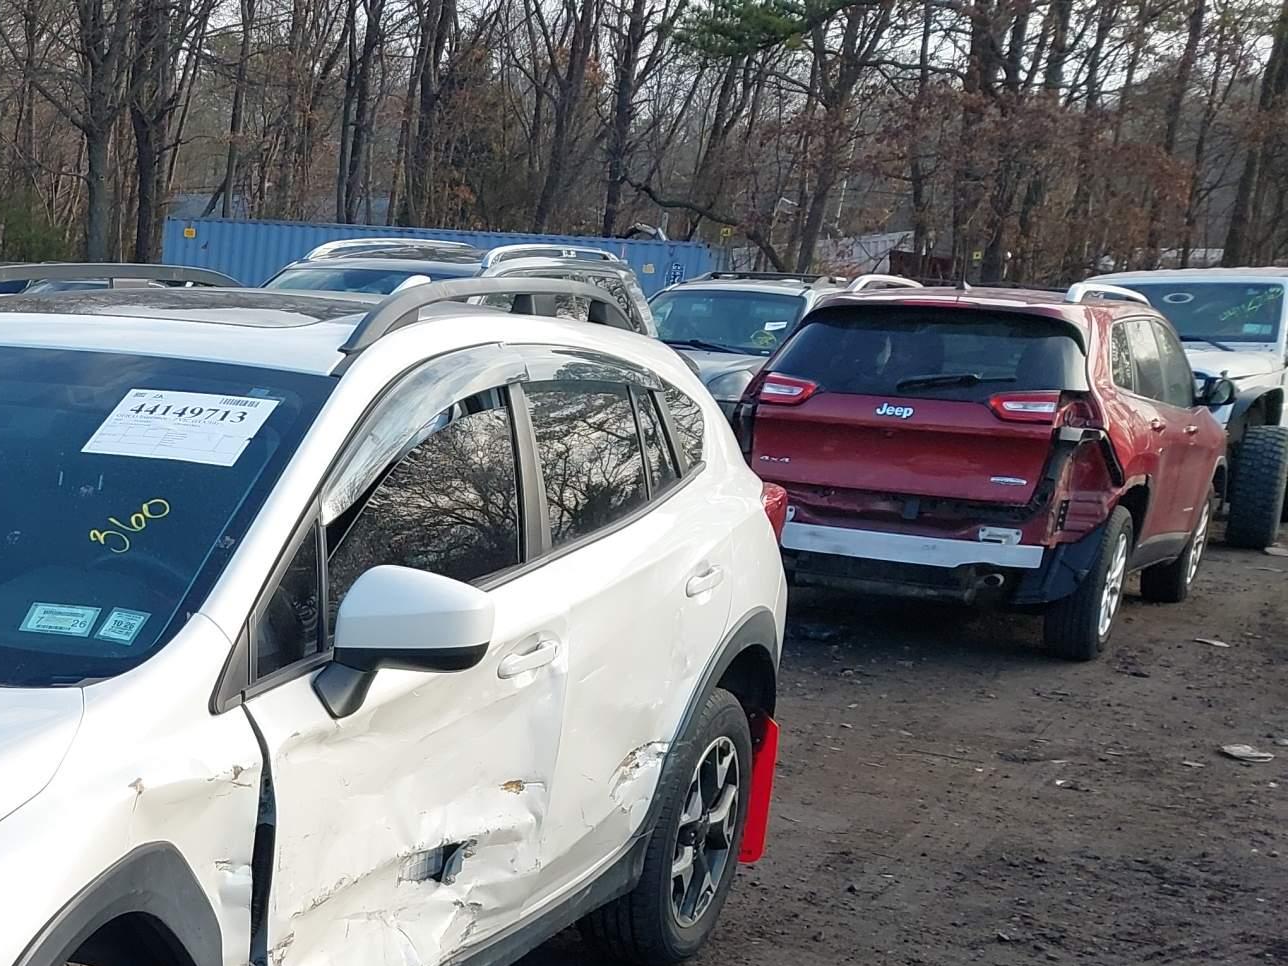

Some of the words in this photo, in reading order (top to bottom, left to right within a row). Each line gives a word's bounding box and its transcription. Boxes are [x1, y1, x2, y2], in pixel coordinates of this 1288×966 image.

[129, 402, 249, 424] 44149713
[876, 402, 914, 419] Jeep
[759, 455, 791, 464] 4x4
[89, 498, 170, 553] 360
[71, 619, 88, 628] 26
